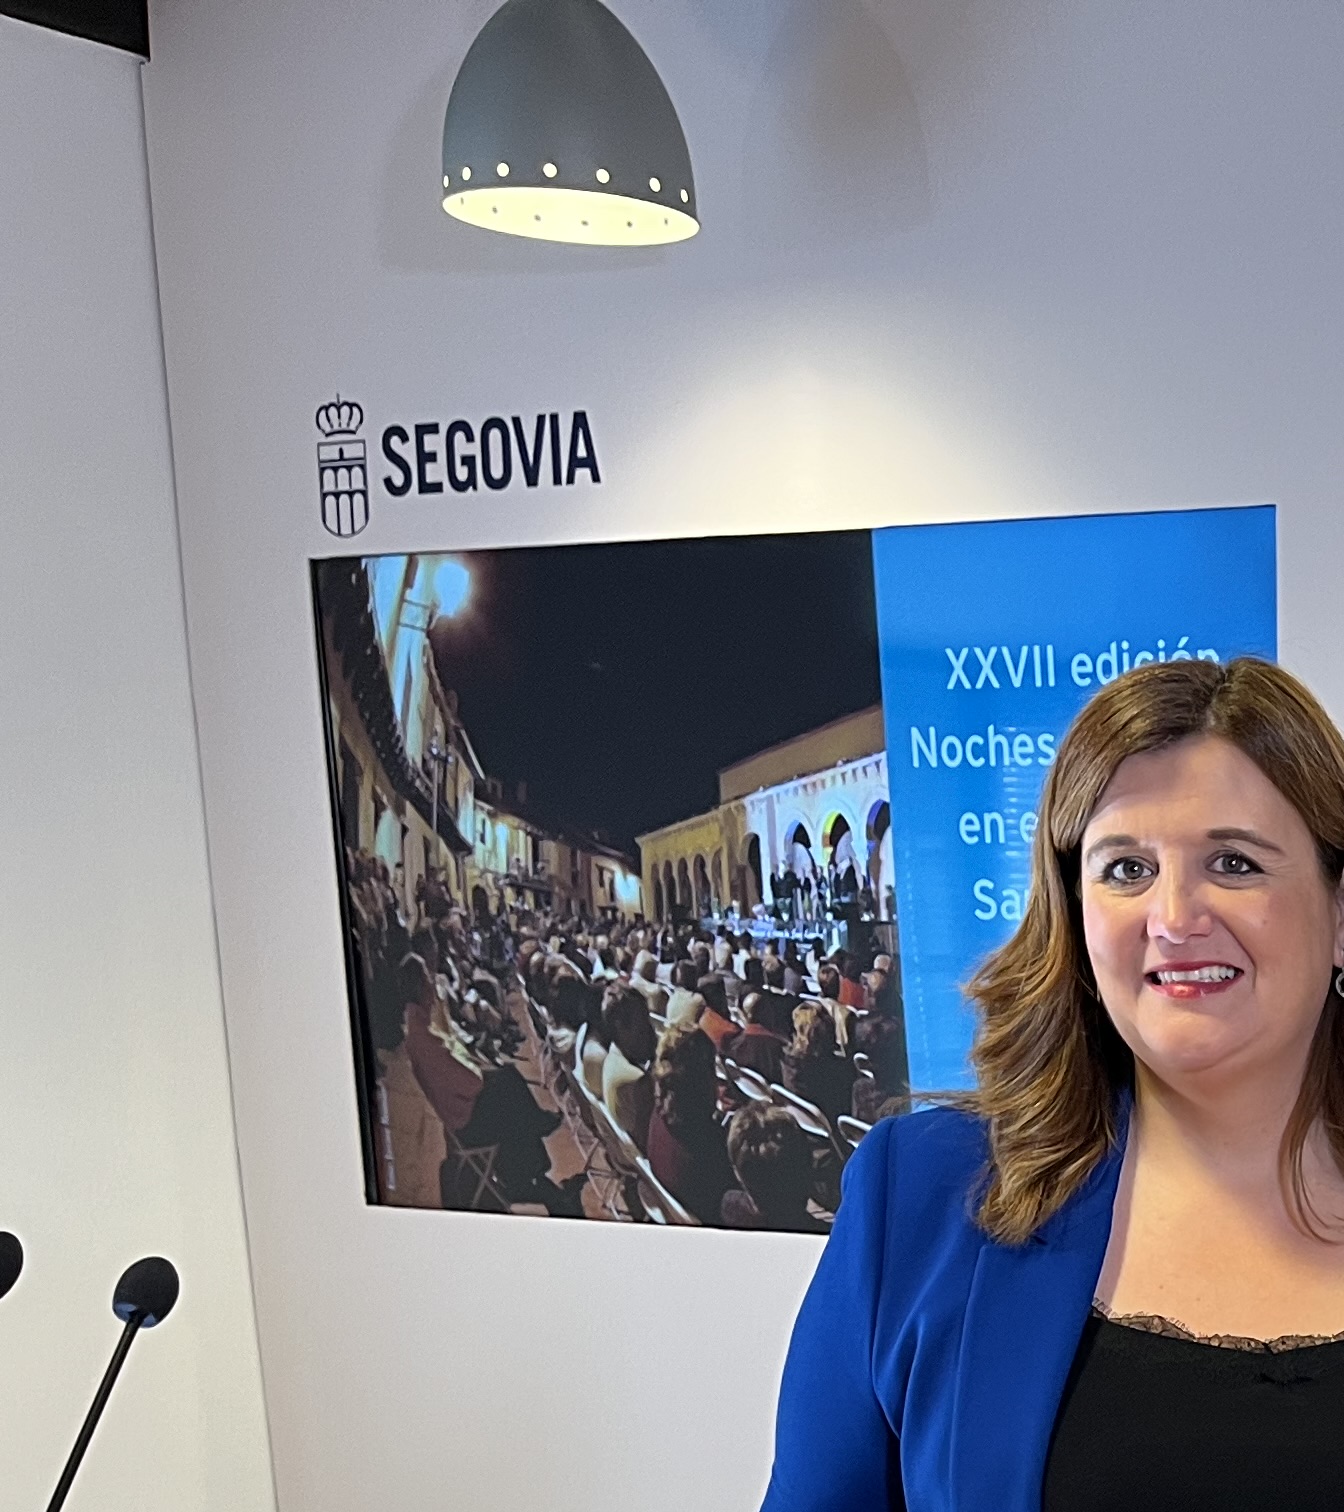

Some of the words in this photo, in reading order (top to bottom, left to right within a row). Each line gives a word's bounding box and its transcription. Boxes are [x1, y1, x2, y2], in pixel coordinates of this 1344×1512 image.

[382, 409, 601, 497] SEGOVIA
[946, 644, 1055, 690] XXVII
[910, 724, 1056, 768] Noches
[958, 811, 1006, 845] en
[1019, 811, 1038, 843] e
[973, 878, 1029, 921] Sa
